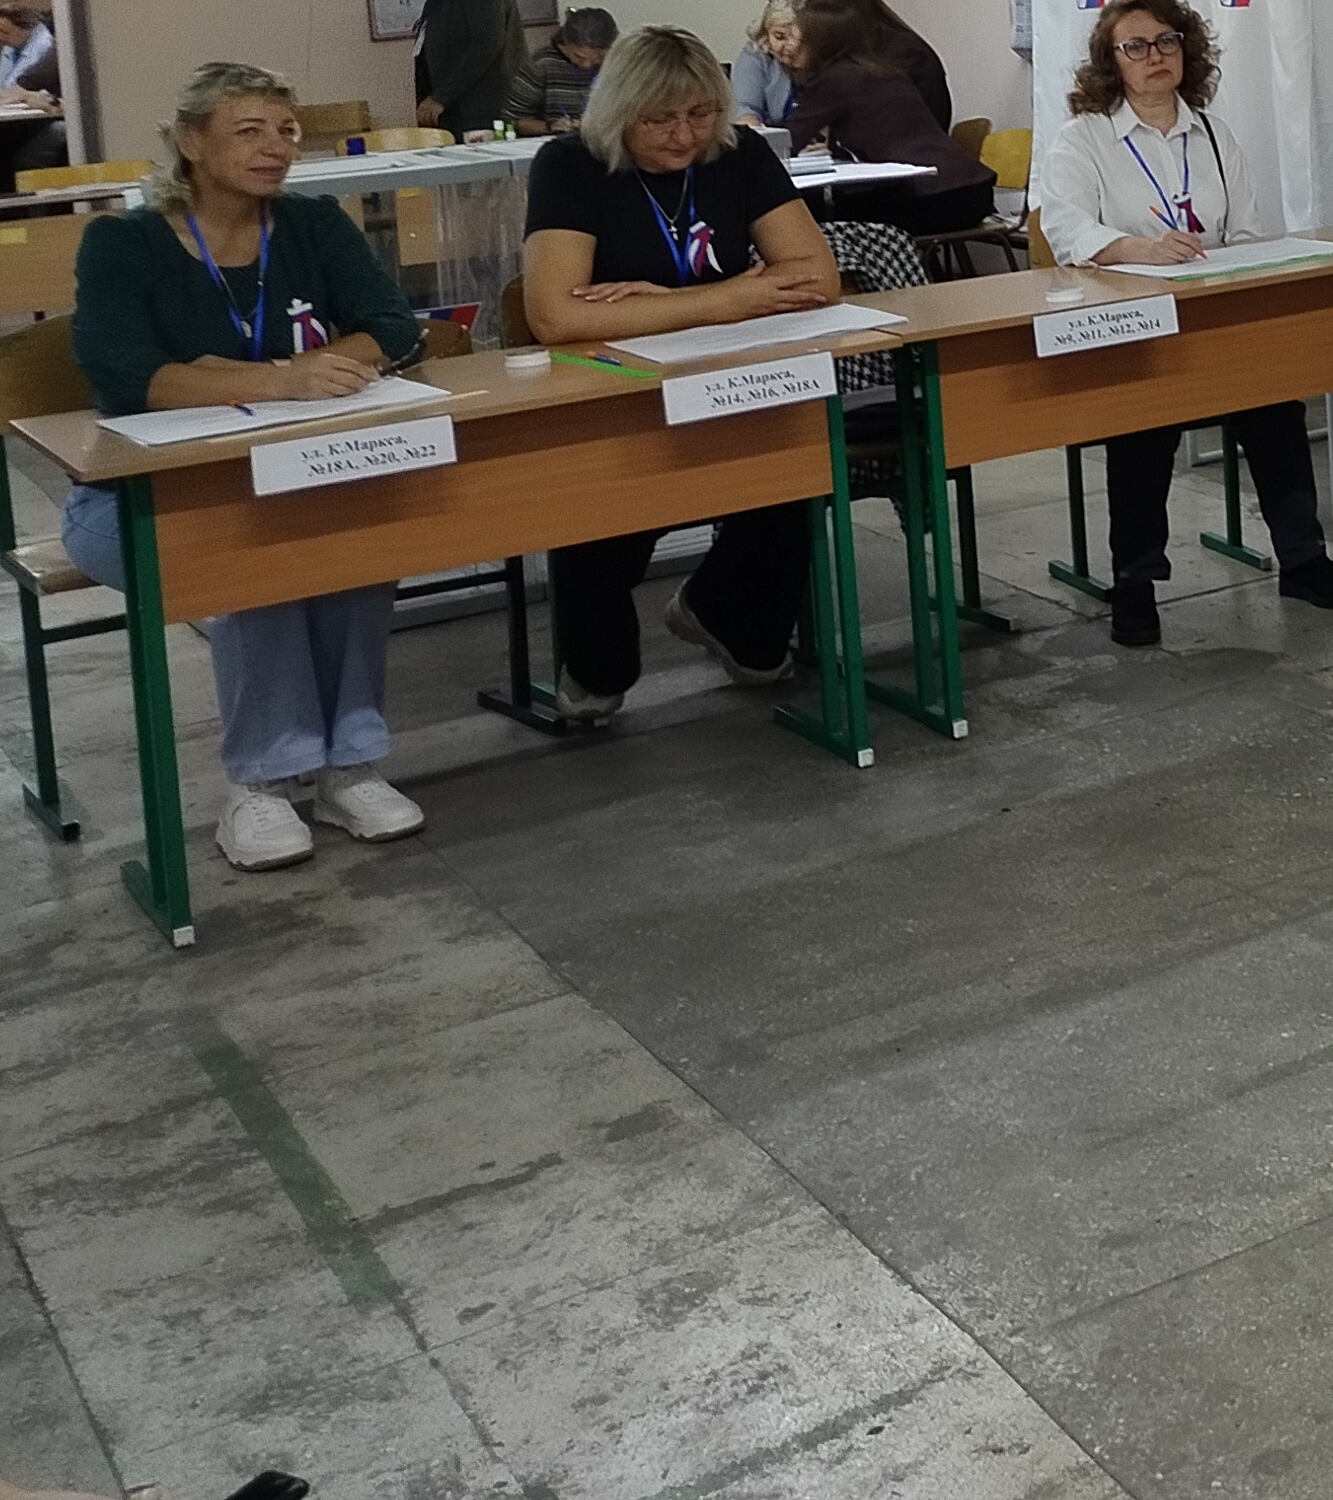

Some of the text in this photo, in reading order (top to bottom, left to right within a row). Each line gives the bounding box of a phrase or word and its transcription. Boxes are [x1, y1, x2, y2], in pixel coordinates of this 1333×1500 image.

[1088, 309, 1144, 326] К.Маркса,
[728, 369, 796, 389] К.Маркса,
[328, 434, 409, 456] К.Маркса,
[402, 444, 437, 461] №22
